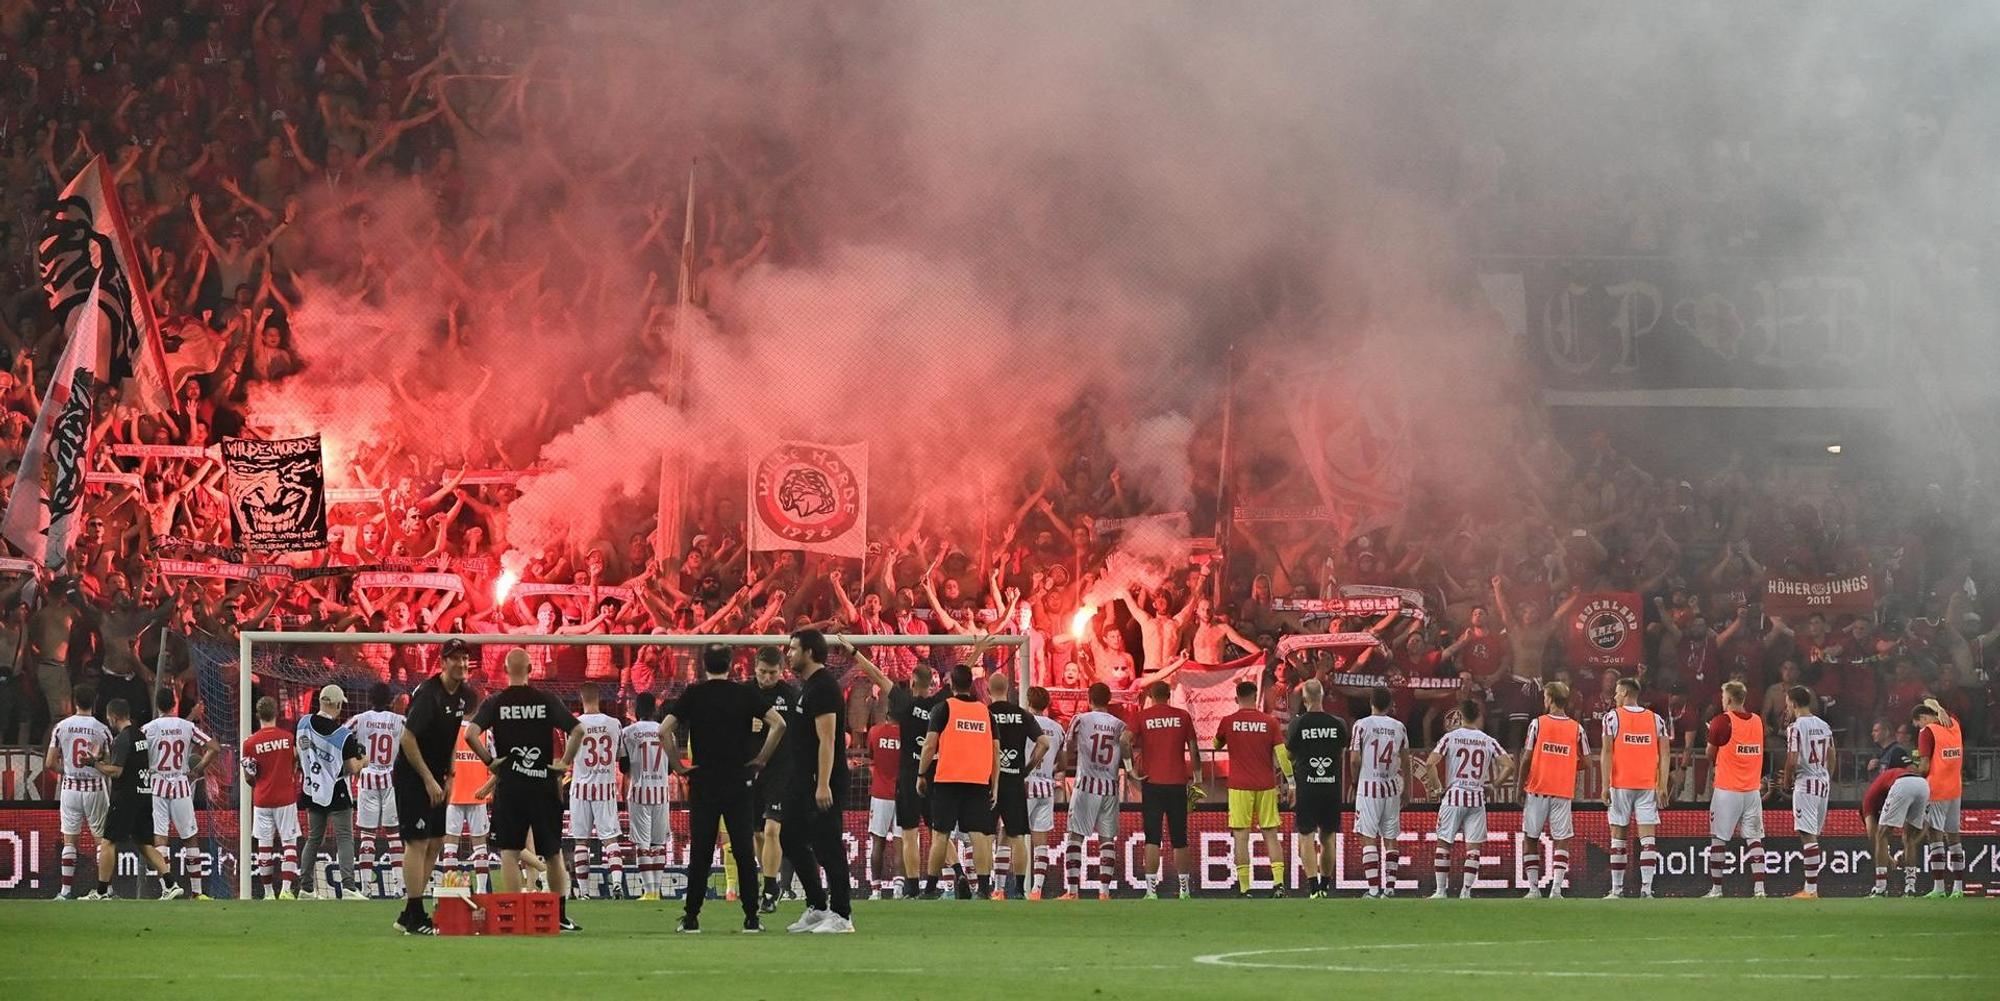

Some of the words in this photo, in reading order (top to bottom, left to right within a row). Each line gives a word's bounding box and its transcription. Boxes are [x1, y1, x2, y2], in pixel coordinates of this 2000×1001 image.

[226, 440, 272, 458] WILDE
[272, 438, 319, 456] HORDE
[758, 449, 801, 496] WILDE
[811, 450, 855, 515] HORDE
[781, 525, 832, 540] 1996
[1767, 577, 1811, 595] HÖHER
[1825, 575, 1869, 595] JUNGS
[1575, 600, 1638, 630] SAUERLAND
[500, 704, 547, 720] REWE
[68, 726, 96, 735] MARTEL
[587, 725, 607, 734] DIETZ
[957, 721, 985, 732] REWE
[1093, 723, 1115, 733] KILIAN
[1146, 717, 1181, 729] REWE
[1233, 721, 1267, 732] REWE
[633, 731, 660, 740] SCHIND
[1301, 727, 1338, 740] REWE
[1625, 734, 1650, 744] REWE
[255, 738, 290, 754] REWE
[368, 732, 393, 765] 19
[1090, 733, 1115, 765] 15
[1454, 737, 1487, 747] THIELMANN
[1542, 742, 1570, 755] REWE
[1737, 745, 1760, 754] REWE
[72, 738, 88, 769] 6
[158, 739, 185, 772] 28
[582, 735, 613, 767] 33
[639, 741, 664, 772] 17
[1371, 738, 1395, 771] 14
[1808, 738, 1826, 768] 47
[1942, 748, 1961, 757] REWE
[1456, 747, 1485, 780] 29
[1306, 775, 1336, 783] hummel
